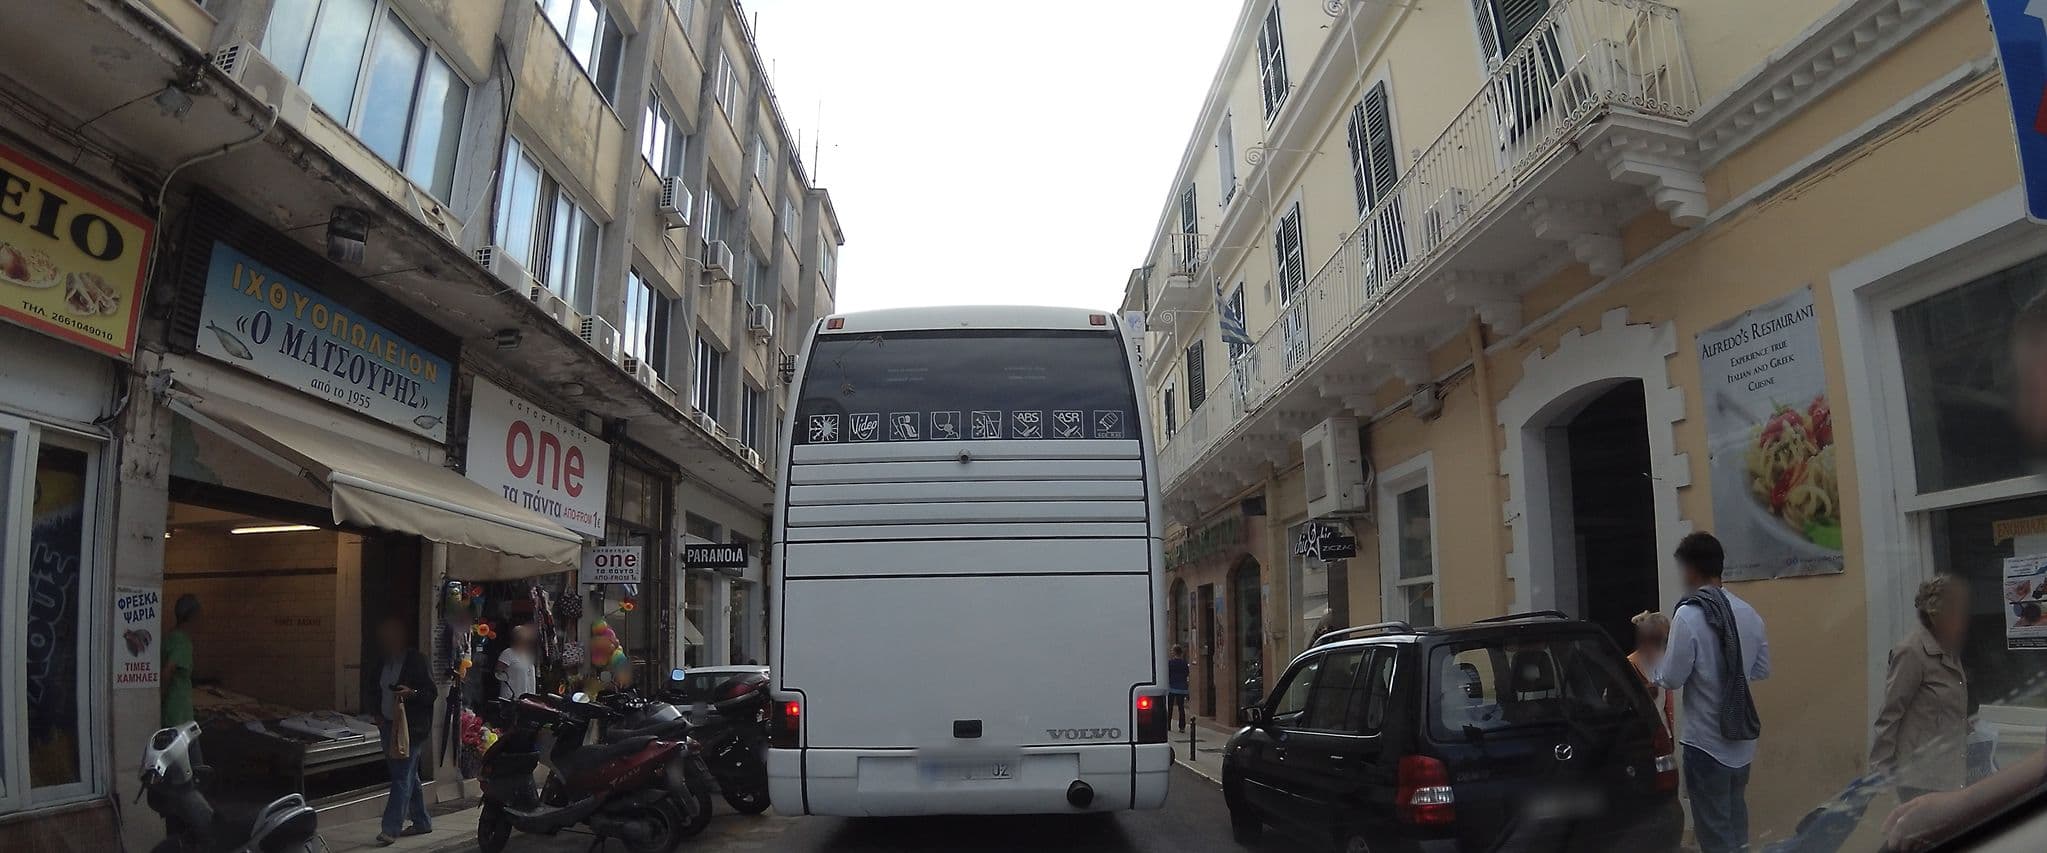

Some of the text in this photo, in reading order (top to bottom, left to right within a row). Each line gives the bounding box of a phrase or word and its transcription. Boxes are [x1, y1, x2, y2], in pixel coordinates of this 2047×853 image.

[52, 312, 113, 342] 2661049010
[231, 262, 438, 384] ΙΧΘΥΟΠΩΛΕΙΟΝ
[1751, 304, 1814, 340] RESTAURANT
[1730, 340, 1788, 367] EXPERIENCE TRUE
[1727, 354, 1795, 383] ITALIAN AND GREEK
[310, 377, 371, 409] από το 1955
[1748, 377, 1776, 392] CUISINE
[851, 415, 878, 434] Video
[1017, 413, 1039, 423] ABS
[1058, 413, 1080, 423] ASR
[506, 420, 585, 498] one
[503, 485, 518, 504] τα
[522, 490, 562, 518] πάντα
[595, 554, 636, 567] one
[118, 592, 158, 610] ΦΡΕΣΚΑ
[124, 607, 155, 623] ΨΑΡΙΑ
[125, 662, 151, 671] ΤΙΜΕΣ
[117, 673, 158, 683] ΧΑΜΗΛΕΣ
[1046, 728, 1121, 739] VOLVO
